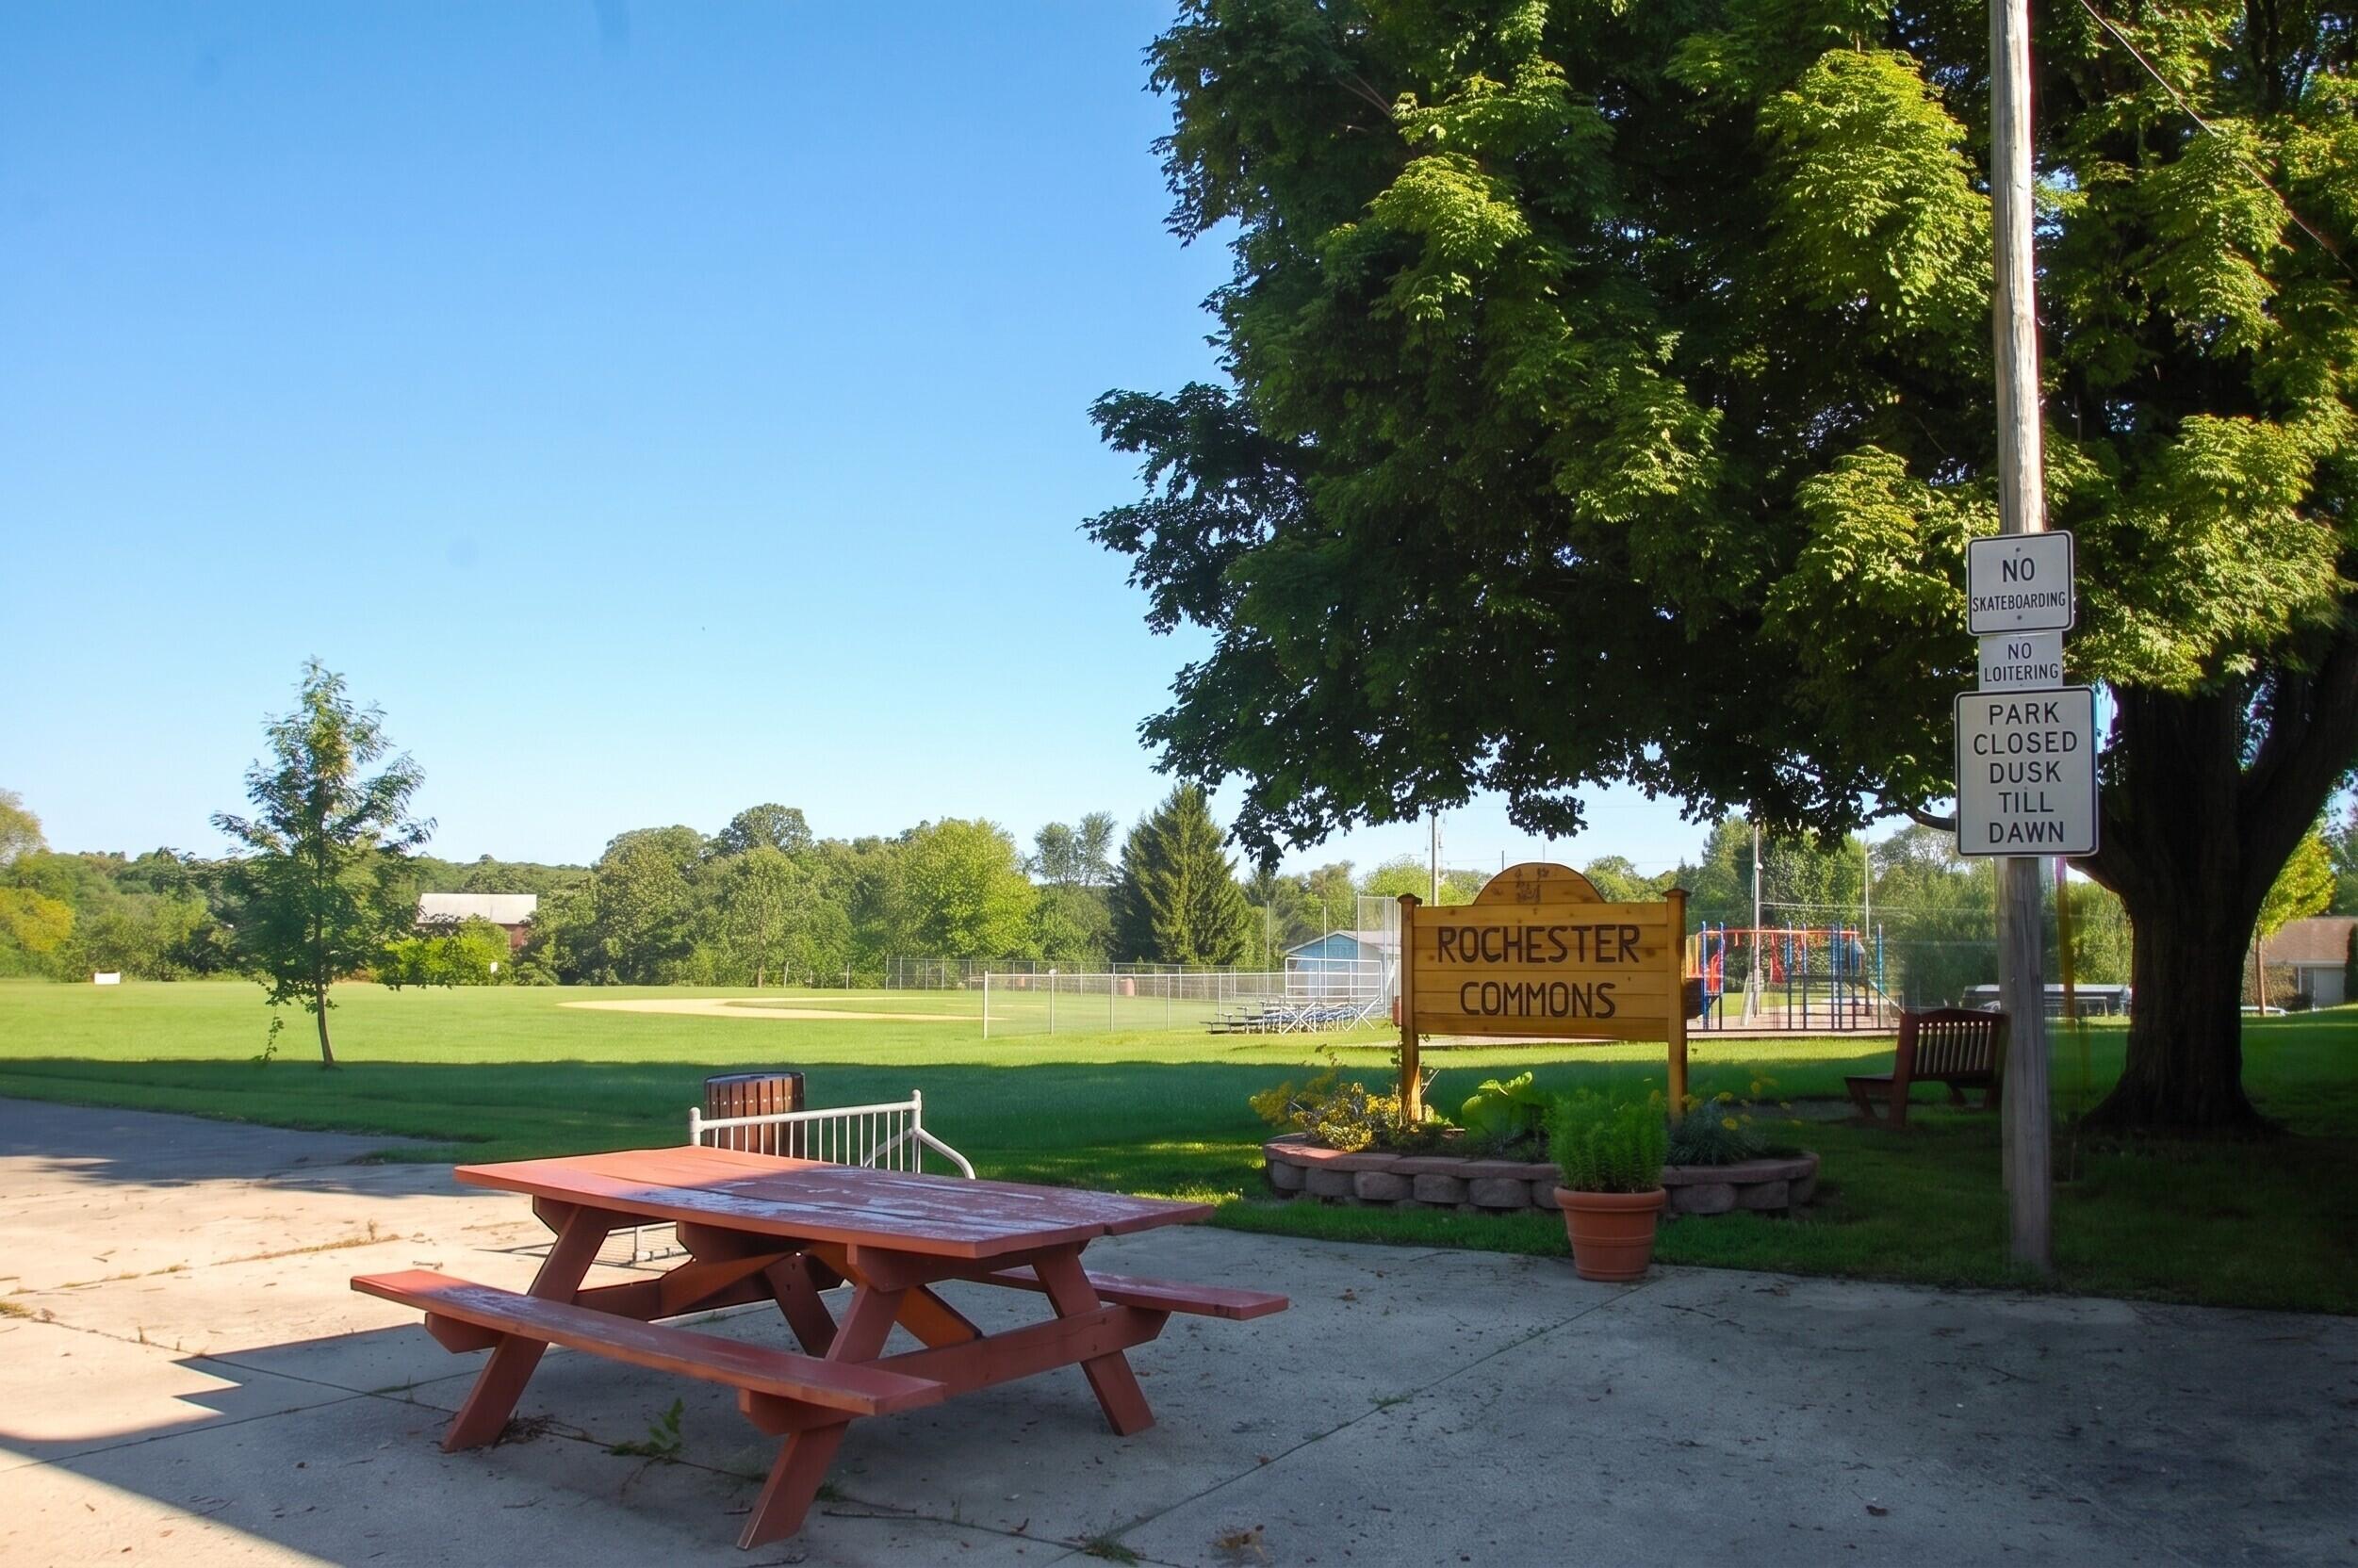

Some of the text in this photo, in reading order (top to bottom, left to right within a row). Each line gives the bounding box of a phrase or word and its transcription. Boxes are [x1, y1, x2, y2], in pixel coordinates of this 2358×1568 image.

[2002, 557, 2036, 582] NO
[1973, 591, 2067, 612] SKATEBOARDING
[2007, 643, 2032, 660] NO
[1985, 663, 2059, 682] LOITERING
[1989, 702, 2060, 726] PARK
[1973, 730, 2078, 756] CLOSED
[1990, 760, 2062, 784] DUSK
[1998, 792, 2055, 813] TILL
[1989, 821, 2064, 843] DAWN
[1437, 924, 1641, 963] ROCHESTER
[1460, 981, 1616, 1019] COMMONS
